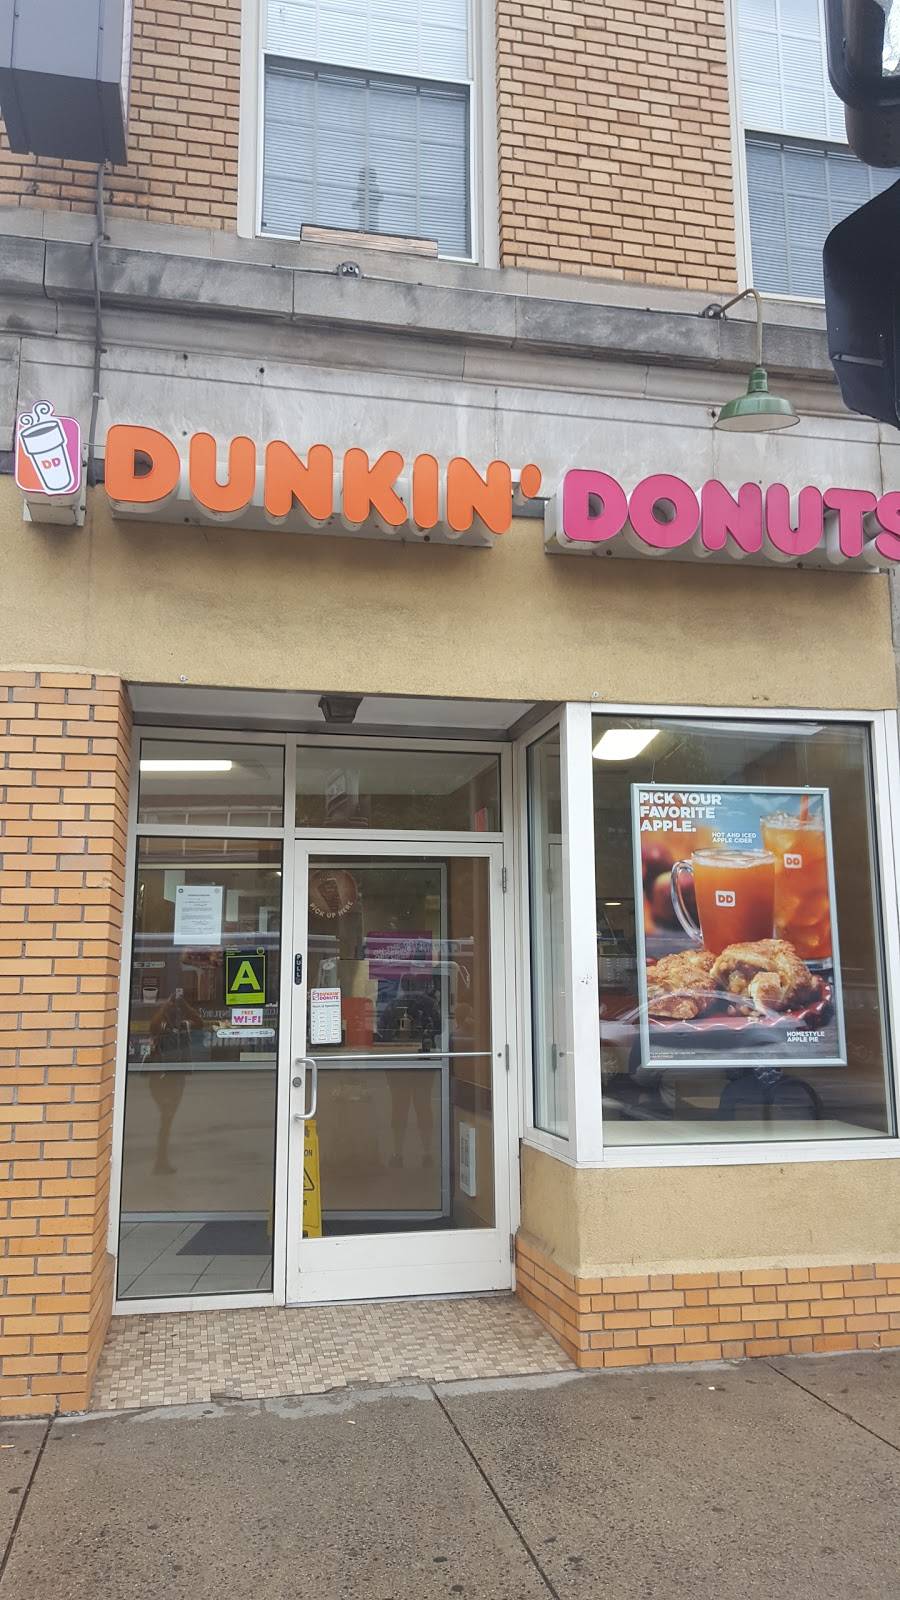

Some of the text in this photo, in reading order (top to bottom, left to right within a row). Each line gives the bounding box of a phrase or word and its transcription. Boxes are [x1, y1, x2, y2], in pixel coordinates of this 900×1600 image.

[40, 457, 61, 470] DD
[105, 424, 542, 535] DUNKIN'
[639, 791, 722, 805] PICK YOUR
[640, 805, 716, 819] FAVORITE
[640, 819, 697, 833] APPLE.
[786, 856, 801, 866] DD
[717, 894, 734, 904] DD
[231, 960, 261, 991] A
[233, 1015, 261, 1024] WI-FI
